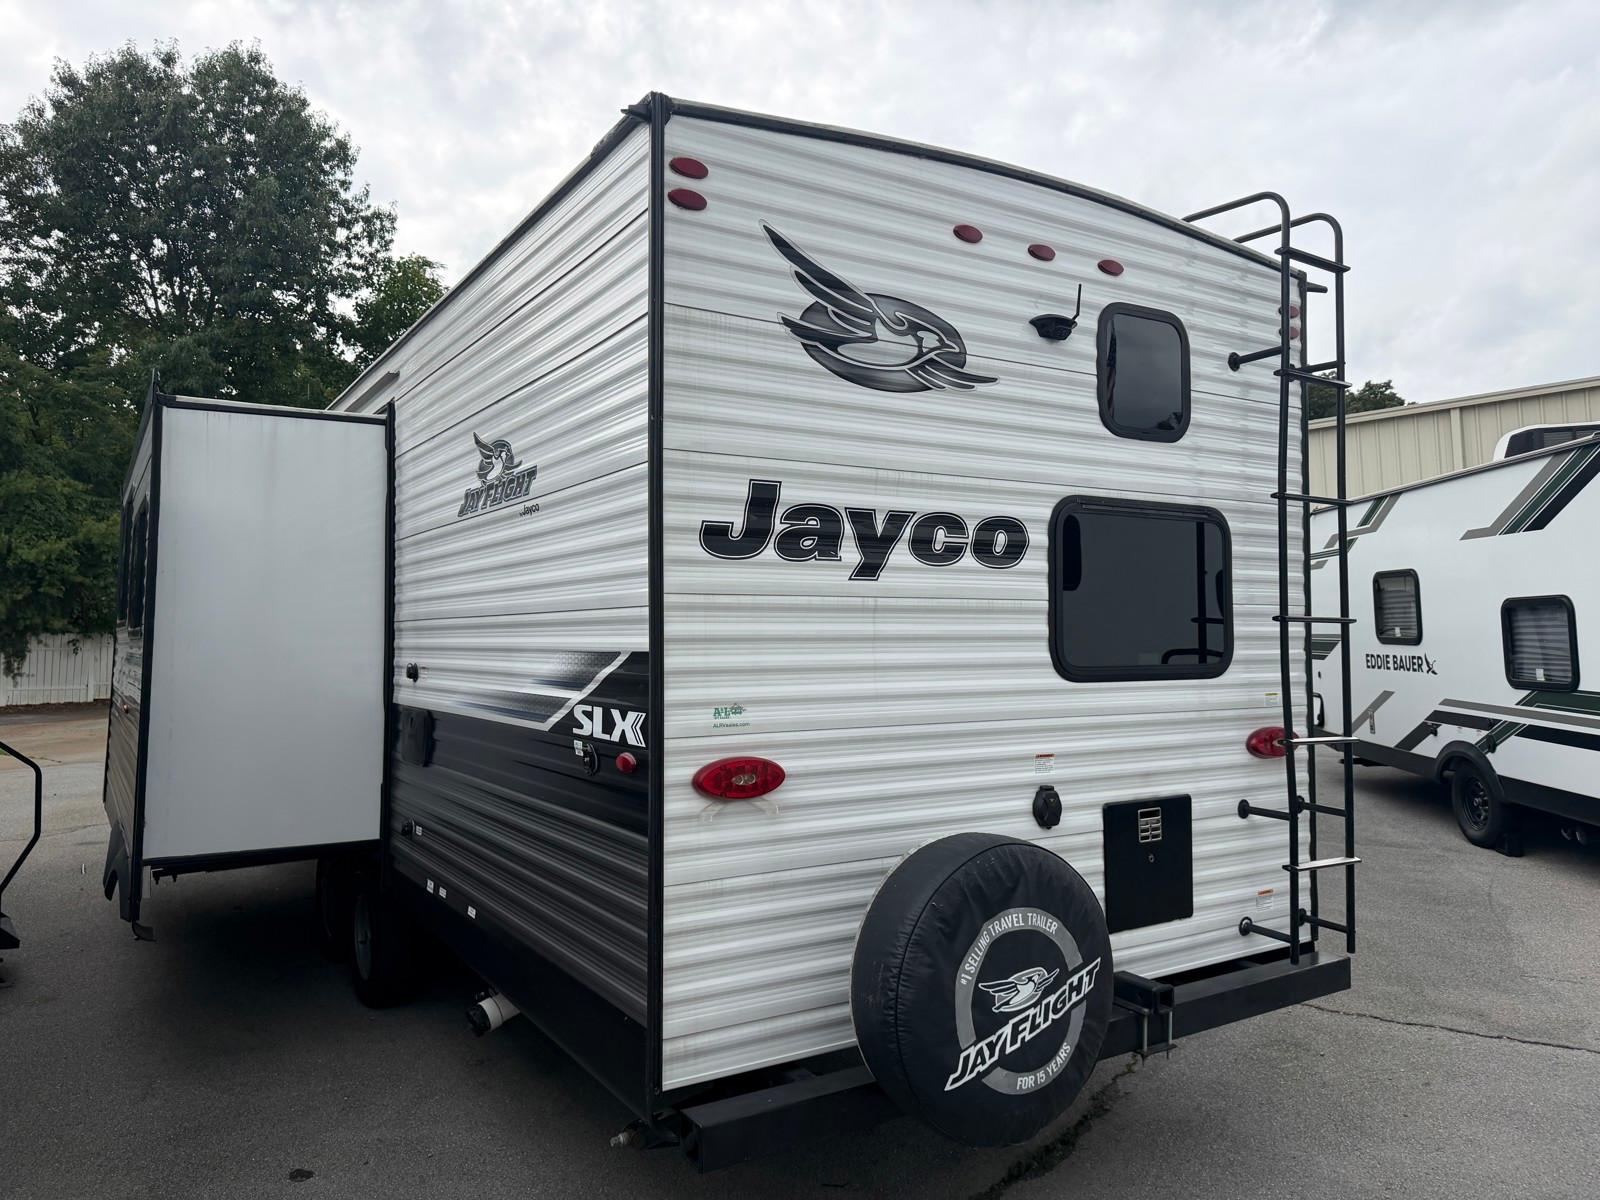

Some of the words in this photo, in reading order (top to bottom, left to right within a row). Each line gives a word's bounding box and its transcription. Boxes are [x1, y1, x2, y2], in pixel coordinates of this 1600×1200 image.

[698, 478, 1030, 581] Jayco
[1365, 653, 1391, 671] EDDIE
[1392, 654, 1424, 673] BAUER
[572, 704, 647, 748] SLX
[988, 912, 1025, 937] TRAVEL
[1026, 912, 1059, 935] TRAILER
[964, 931, 990, 974] SELLING
[960, 970, 973, 986] #1
[1016, 1074, 1035, 1091] FOR
[1036, 1072, 1046, 1086] 15
[1046, 1041, 1071, 1077] YEARS
